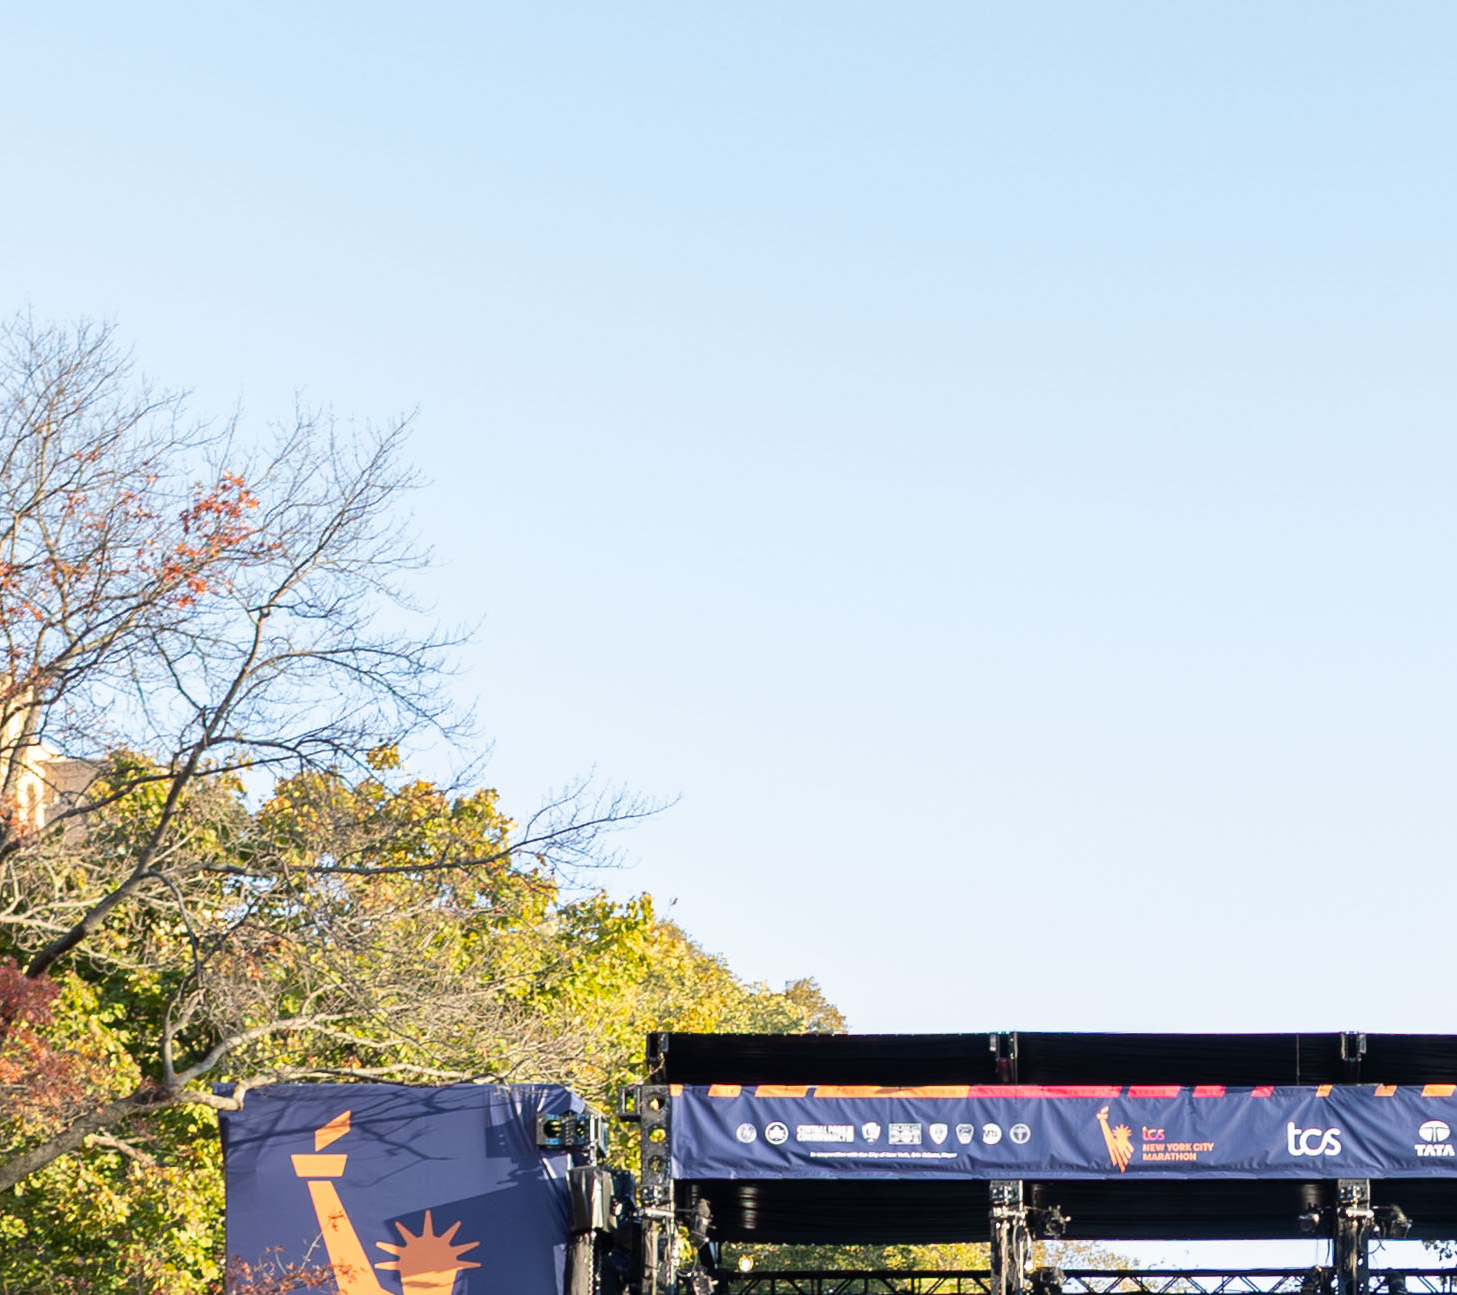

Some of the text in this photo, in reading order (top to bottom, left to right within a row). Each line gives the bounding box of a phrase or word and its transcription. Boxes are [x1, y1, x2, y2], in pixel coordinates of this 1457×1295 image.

[1142, 1126, 1165, 1141] tcs
[1287, 1121, 1341, 1156] tcs
[1143, 1142, 1214, 1152] NEW YORK CITY
[1414, 1144, 1455, 1157] TATA
[1143, 1152, 1197, 1161] MARATHON
